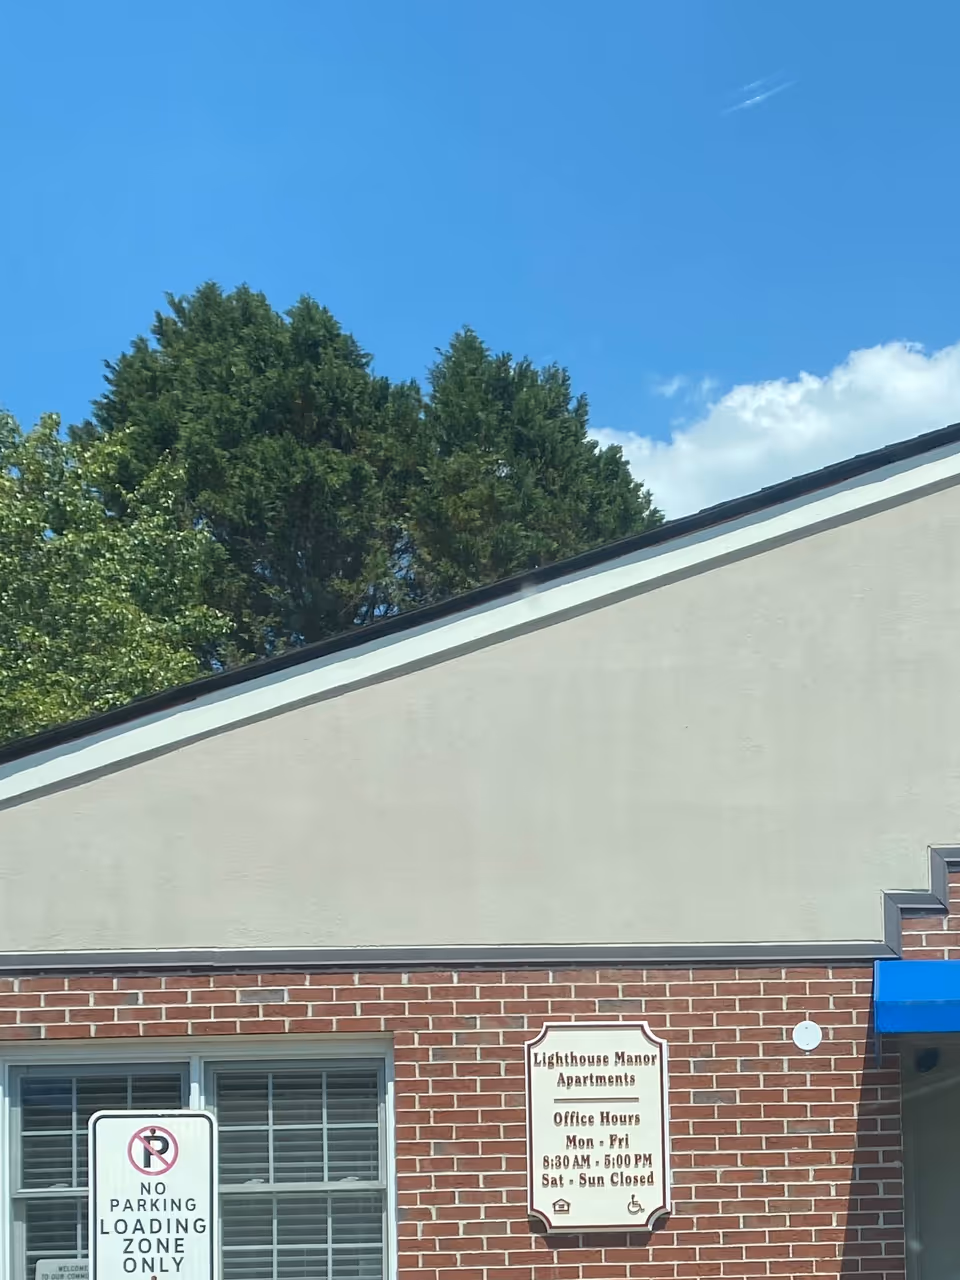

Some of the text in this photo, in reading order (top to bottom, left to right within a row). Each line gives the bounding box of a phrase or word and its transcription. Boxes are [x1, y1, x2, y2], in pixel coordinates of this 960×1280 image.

[533, 1051, 658, 1069] Lighthouse Manor
[556, 1072, 636, 1089] Apartments
[553, 1111, 641, 1127] Office Hours
[566, 1134, 594, 1149] Mon
[609, 1133, 629, 1149] Fri
[542, 1155, 570, 1169] 8:30
[572, 1154, 591, 1169] AM
[604, 1154, 631, 1169] 5:00
[634, 1153, 653, 1168] PM
[541, 1173, 564, 1188] Sat
[579, 1173, 605, 1187] Sun
[610, 1171, 655, 1187] Closed
[140, 1182, 166, 1195] NO
[110, 1198, 197, 1212] PARKING
[100, 1218, 207, 1235] LOADING
[122, 1238, 185, 1254] ZONE
[122, 1256, 185, 1273] ONLY
